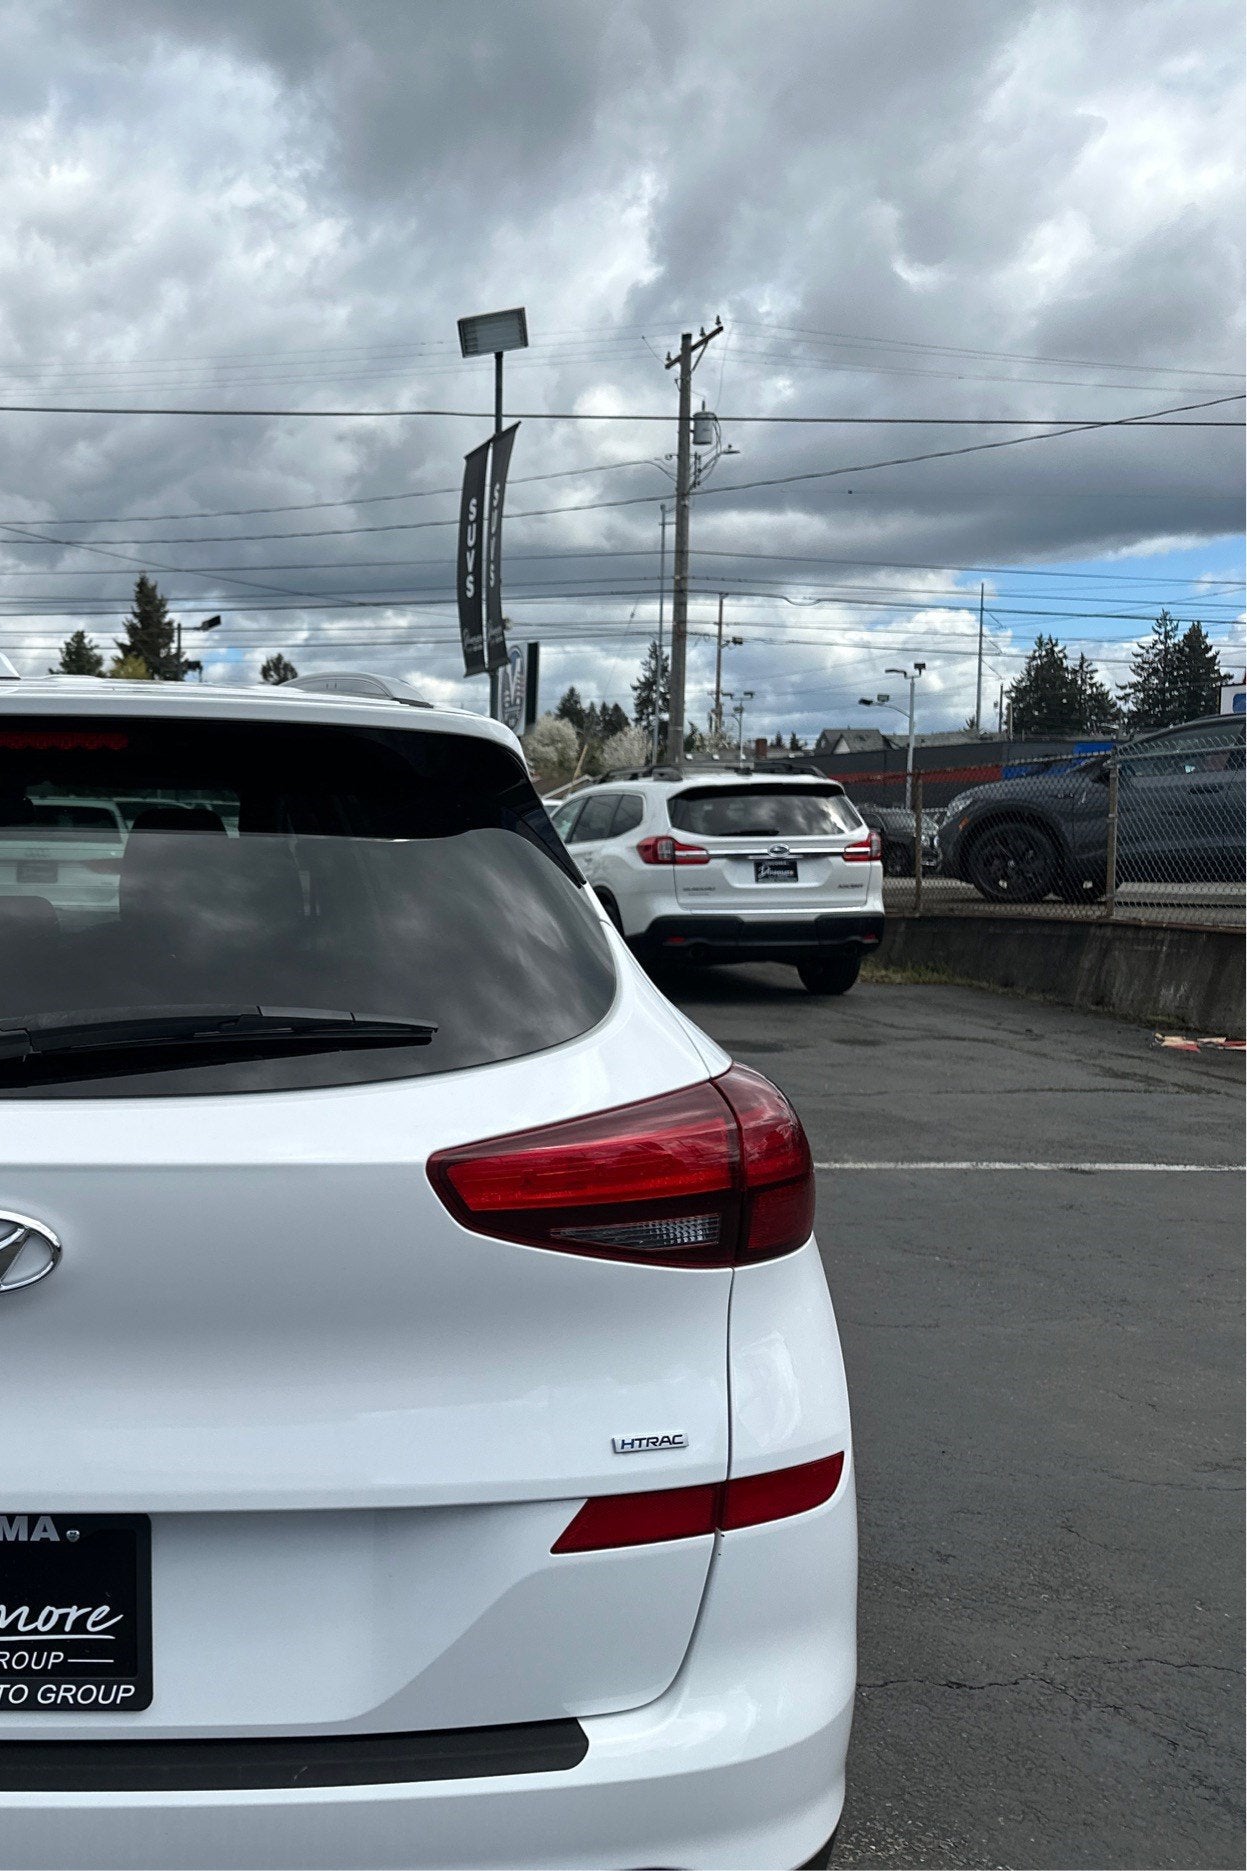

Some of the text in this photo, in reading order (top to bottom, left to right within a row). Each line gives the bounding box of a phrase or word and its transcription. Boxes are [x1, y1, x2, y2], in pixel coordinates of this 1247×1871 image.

[465, 497, 477, 598] SUVS
[620, 1434, 684, 1450] HTRAC
[36, 1683, 136, 1705] GROUP
